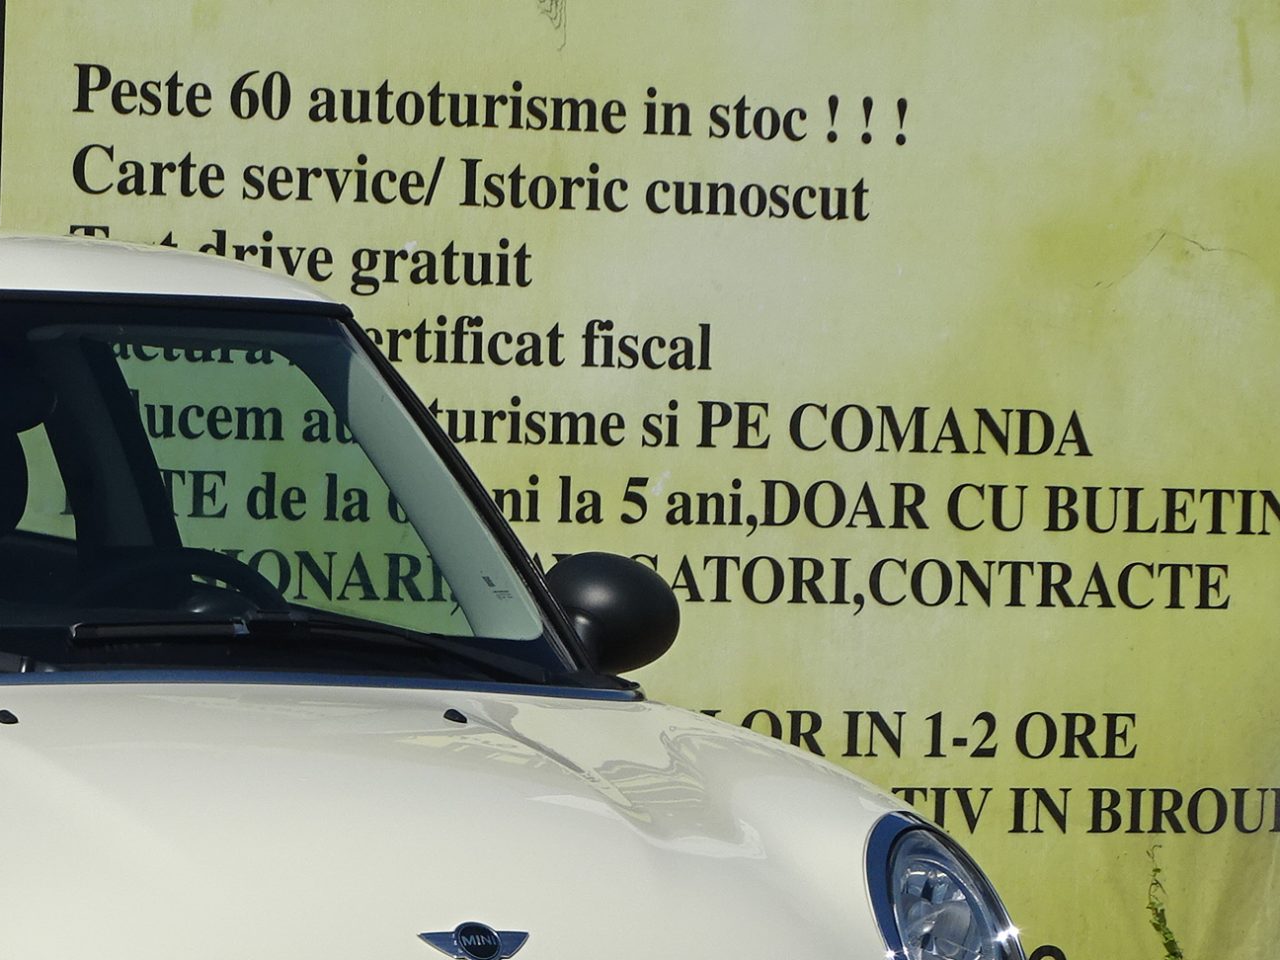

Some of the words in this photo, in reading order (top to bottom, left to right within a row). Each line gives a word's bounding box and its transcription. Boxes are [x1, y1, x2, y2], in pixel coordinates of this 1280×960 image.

[72, 63, 212, 118] Peste
[229, 70, 292, 121] 60
[308, 79, 627, 134] autoturisme
[642, 87, 691, 137] in
[708, 95, 808, 141] stoc
[72, 144, 225, 199] Carte
[241, 154, 446, 205] service/
[458, 157, 628, 214] Istoric
[645, 177, 870, 221] cunoscut
[198, 229, 334, 282] drive
[350, 238, 533, 296] gratuit
[581, 319, 712, 371] fiscal
[130, 389, 285, 441] ucem
[640, 398, 680, 449] si
[697, 400, 772, 451] PE
[788, 402, 1094, 458] COMANDA
[158, 469, 228, 519] TE
[246, 471, 307, 522] de
[324, 472, 370, 522] la
[491, 474, 540, 522] ni
[558, 475, 604, 524] la
[620, 477, 650, 525] 5
[947, 483, 1027, 533] CU
[1045, 486, 1280, 536] BULETIN
[841, 710, 907, 759] IN
[923, 710, 998, 759] 1-2
[1014, 711, 1138, 760] ORE
[1008, 787, 1072, 835] IN
[461, 934, 497, 946] MINI
